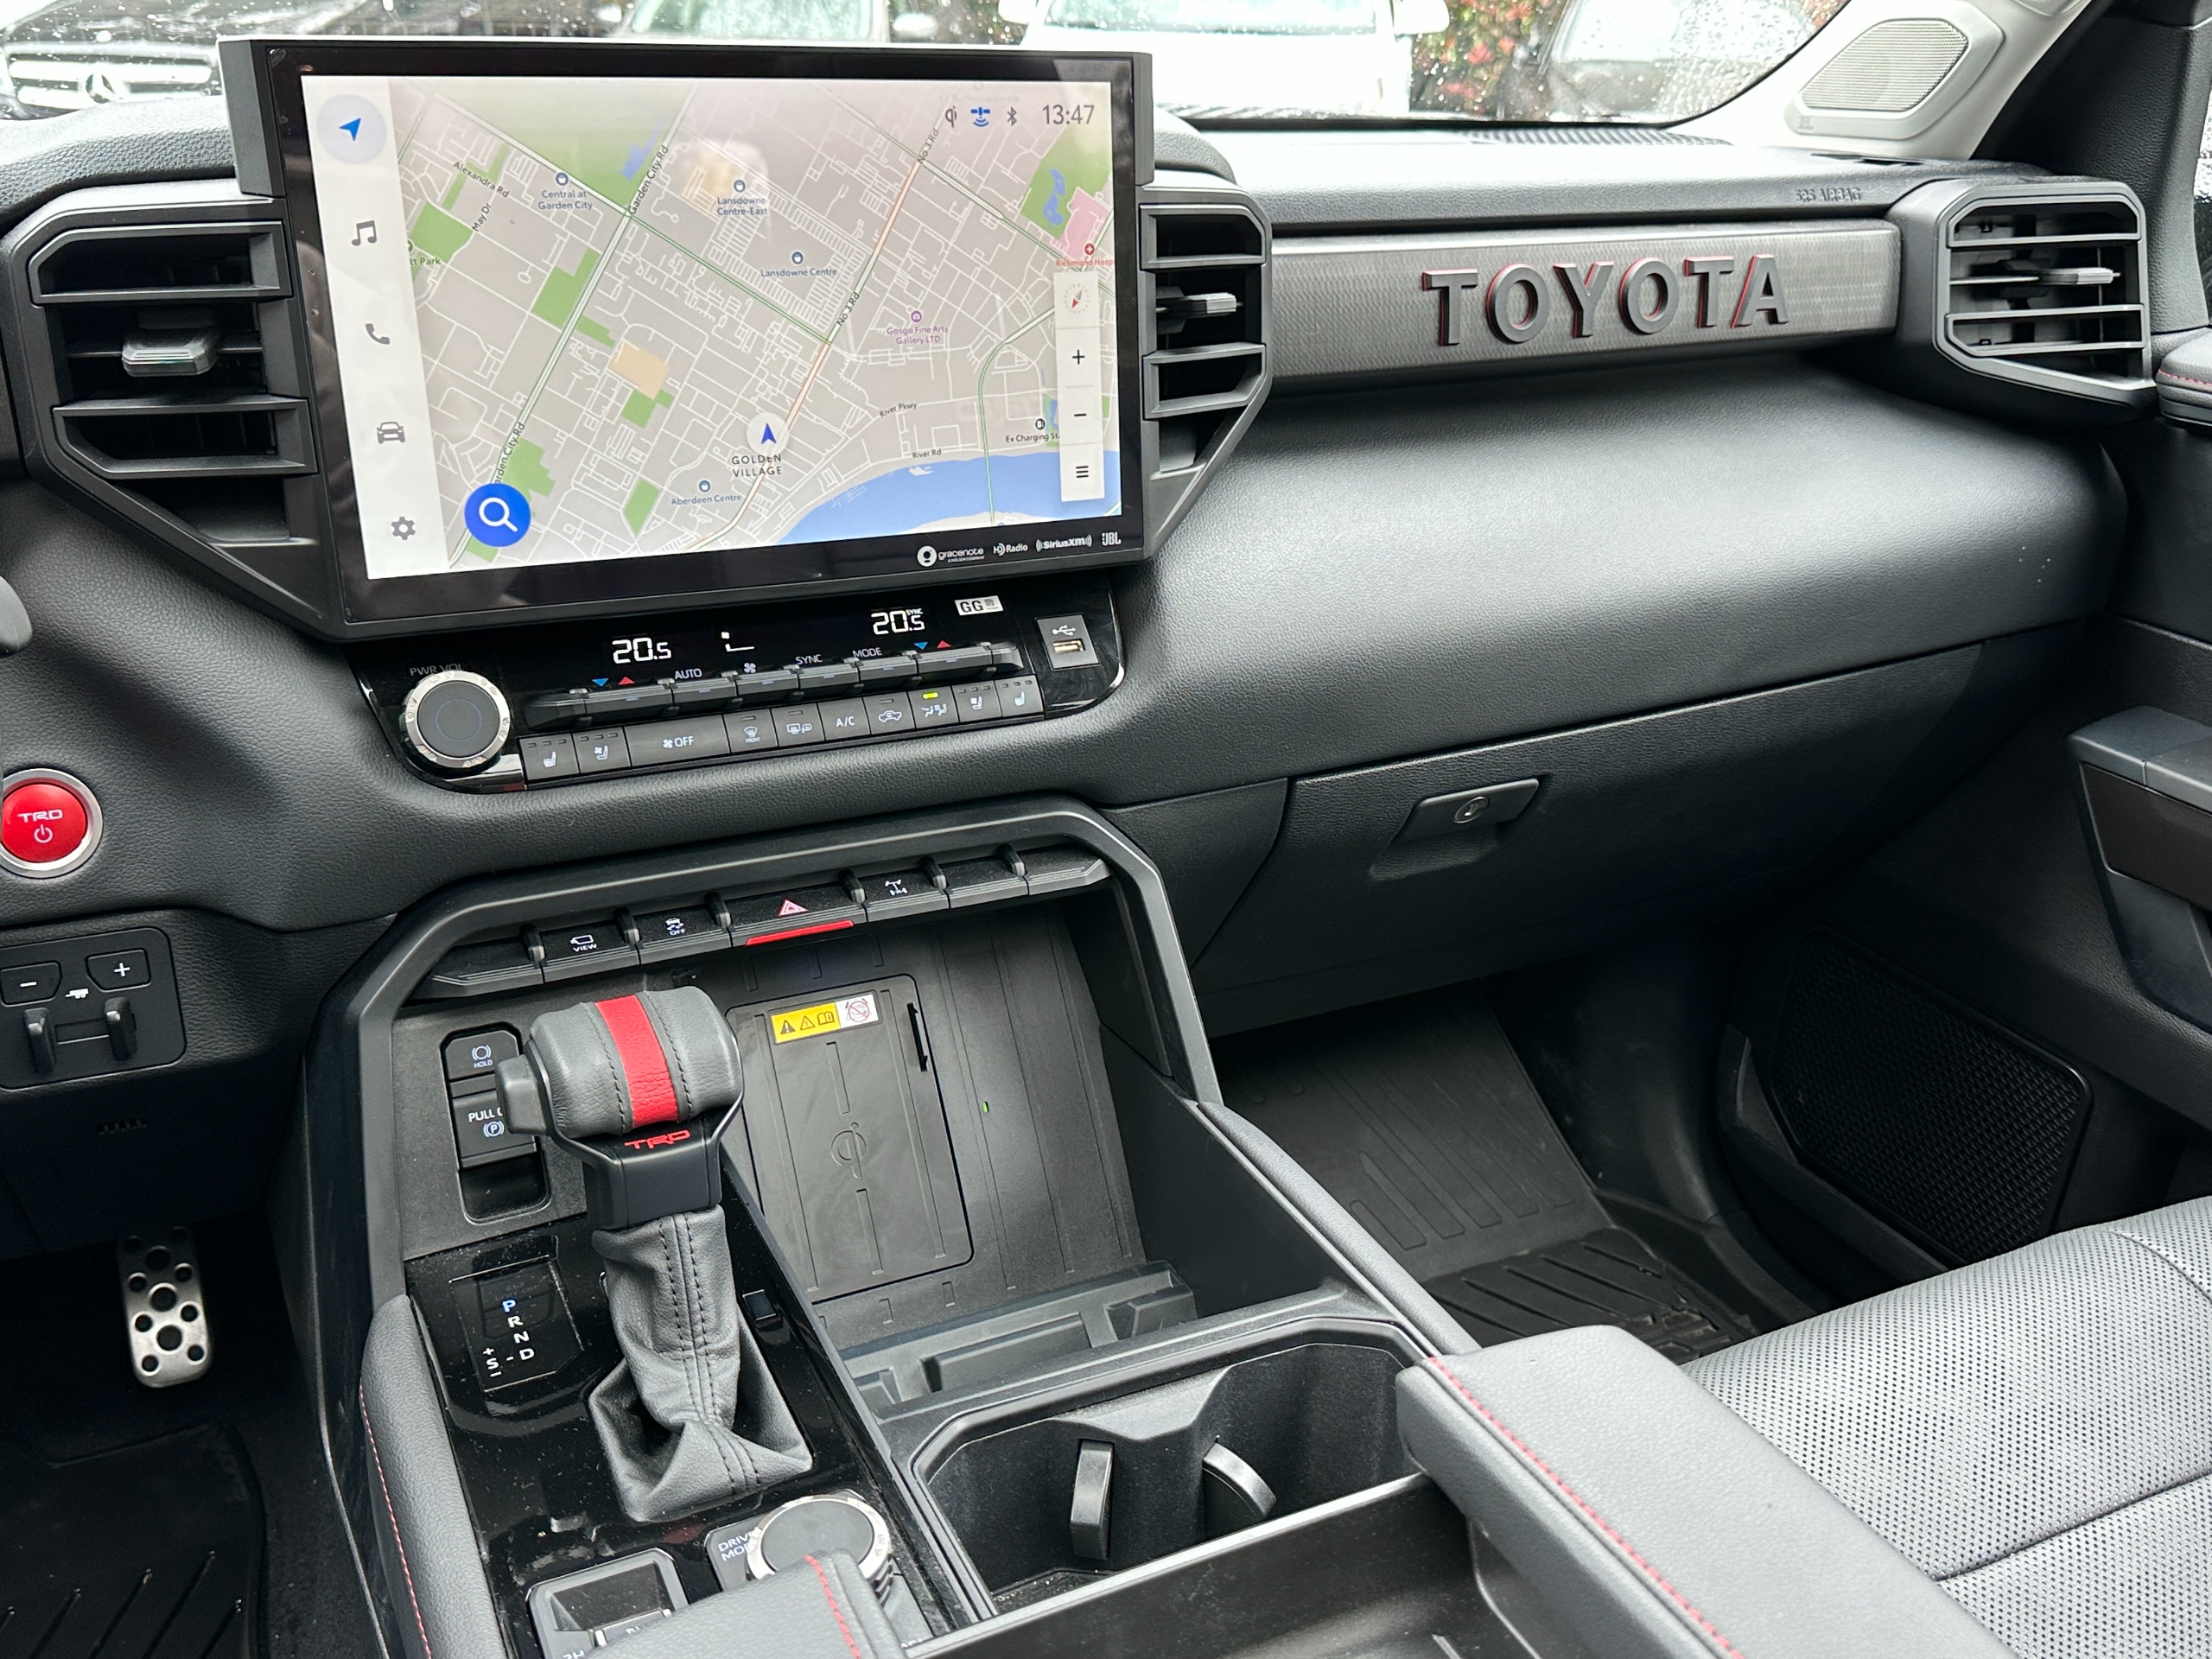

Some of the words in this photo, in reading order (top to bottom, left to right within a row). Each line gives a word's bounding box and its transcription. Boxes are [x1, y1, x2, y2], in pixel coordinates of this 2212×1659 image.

[1042, 105, 1095, 124] 13:47
[928, 129, 939, 143] Rd
[925, 142, 932, 150] 3
[917, 149, 928, 164] No
[453, 161, 498, 191] Alexandra
[495, 182, 510, 198] Rd
[628, 181, 650, 215] Garden
[646, 159, 664, 180] City
[657, 145, 670, 160] Rd
[541, 190, 575, 200] Central
[576, 190, 588, 199] at
[717, 196, 766, 206] Lansdowne
[1819, 188, 1861, 202] AIRBAG
[537, 200, 573, 211] Garden
[574, 200, 594, 212] City
[717, 207, 768, 216] Centre-East
[472, 213, 486, 232] May
[480, 202, 493, 216] Dr
[410, 257, 418, 266] tt
[420, 257, 442, 265] Park
[1095, 258, 1114, 267] Hosp
[760, 268, 808, 277] Lansdowne
[810, 267, 838, 276] Centre
[1422, 253, 1789, 346] TOYOTA
[836, 314, 849, 327] No
[845, 304, 852, 314] 3
[849, 291, 861, 304] Rd
[887, 327, 914, 336] Gosgo
[915, 326, 933, 334] Fine
[933, 325, 949, 334] Arts
[896, 335, 924, 346] Gallery
[925, 335, 941, 344] LTD
[880, 405, 898, 418] River
[899, 402, 918, 413] Pkwy
[1015, 433, 1050, 442] Charging
[495, 457, 508, 484] arden
[503, 436, 519, 455] City
[512, 422, 525, 436] Rd
[731, 453, 782, 465] GOLDEN
[912, 449, 931, 459] River
[931, 448, 942, 457] Rd
[732, 465, 783, 477] VILLAGE
[671, 495, 713, 506] Aberdeen
[714, 493, 742, 504] Centre
[1102, 531, 1122, 546] JBL
[938, 548, 984, 561] gracenote
[1006, 543, 1028, 554] Radio
[906, 607, 924, 616] SYNC
[960, 600, 984, 613] GG
[871, 610, 925, 635] 20.5
[612, 637, 671, 664] 20.5
[852, 646, 882, 658] MODE
[795, 654, 823, 664] SYNC
[410, 665, 438, 677] PWR
[674, 668, 702, 680] AUTO
[836, 715, 855, 728] A/C
[674, 735, 694, 748] OFF
[17, 809, 64, 823] TRD
[572, 943, 597, 951] VIEW
[474, 1059, 493, 1069] HOLD
[467, 1109, 495, 1122] PULL
[624, 1129, 691, 1149] TRD
[502, 1299, 516, 1313] P
[507, 1315, 524, 1328] R
[513, 1331, 530, 1344] N
[486, 1357, 499, 1371] S
[519, 1348, 535, 1361] D
